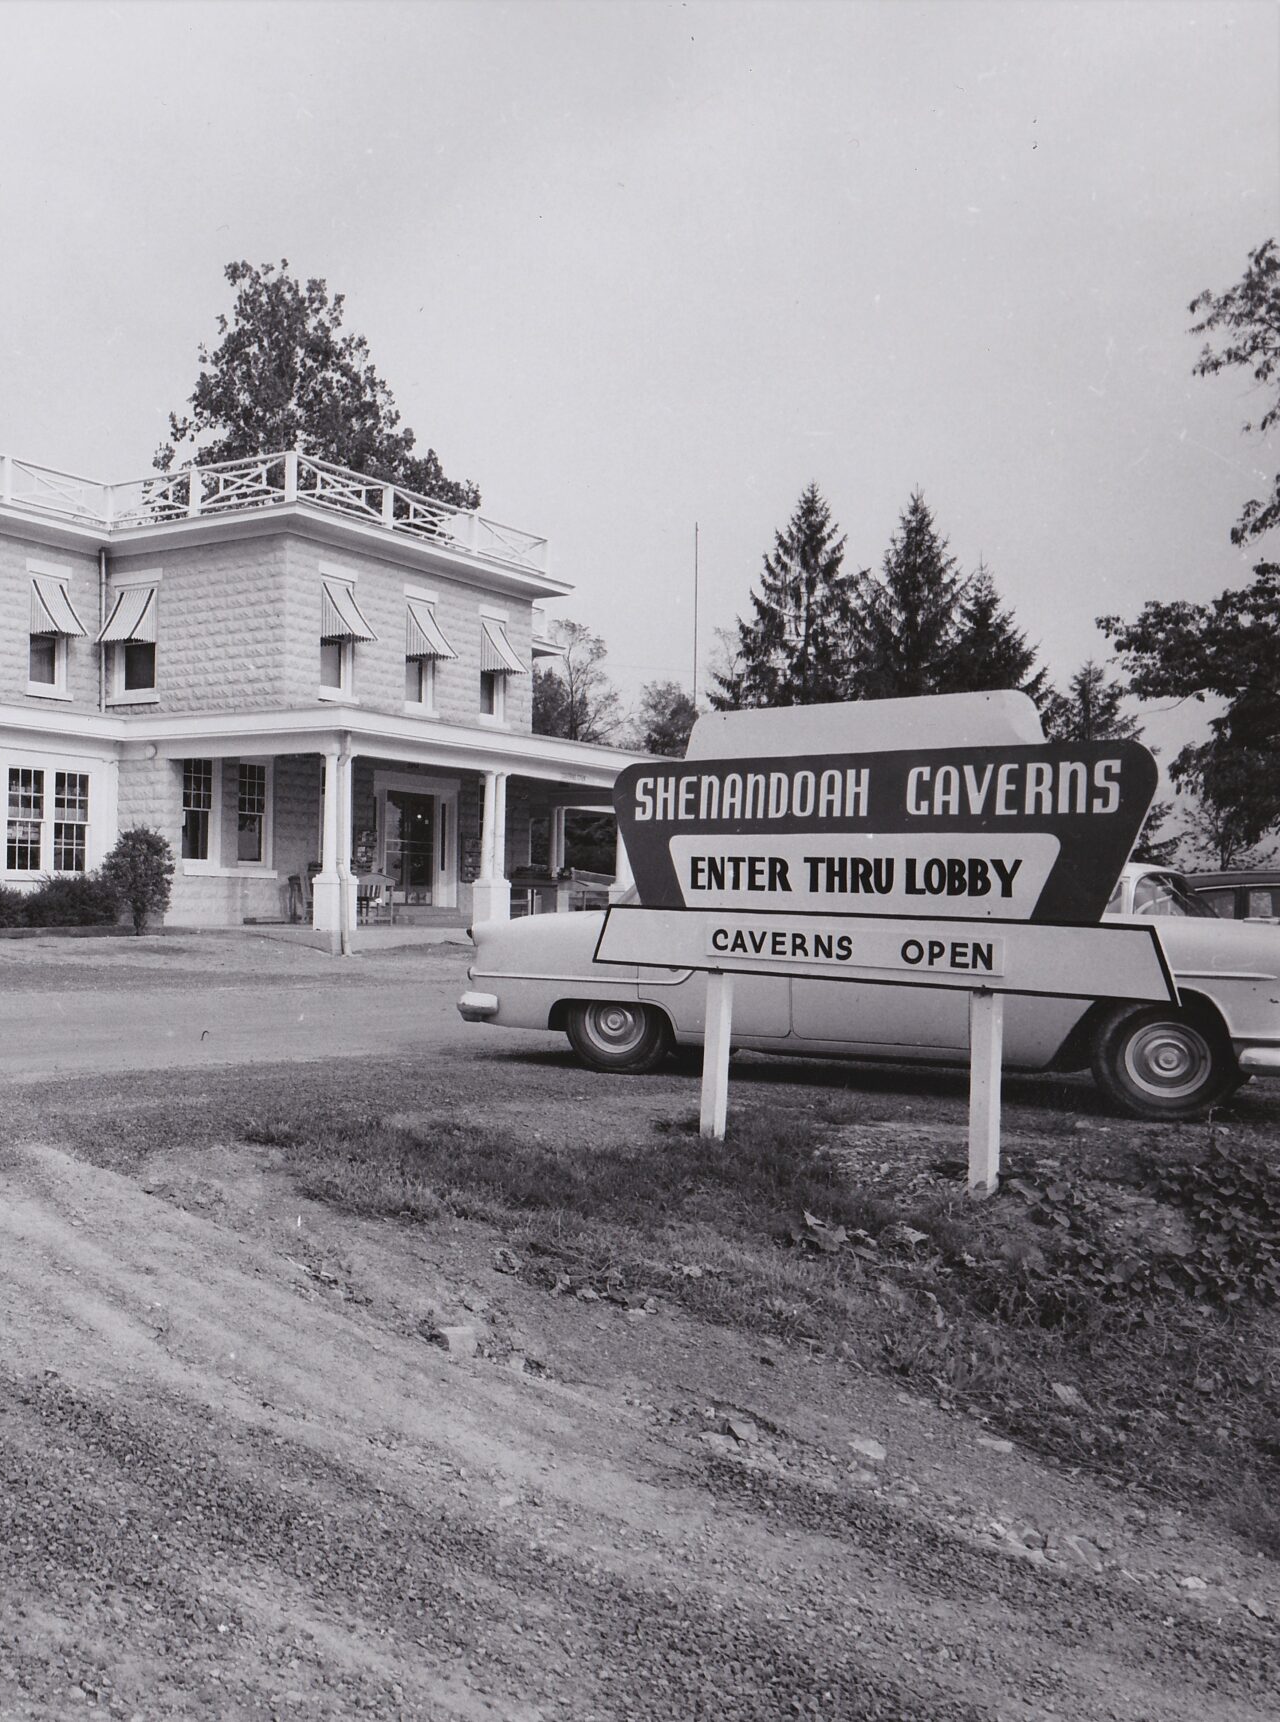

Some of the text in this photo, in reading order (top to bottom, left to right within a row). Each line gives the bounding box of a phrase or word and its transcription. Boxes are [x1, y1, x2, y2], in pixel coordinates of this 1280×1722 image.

[634, 759, 1121, 821] SHENANDOAH CAVERNS
[690, 856, 1022, 898] ENTER THRU LOBBY
[712, 928, 993, 970] CAVERNS OPEN
